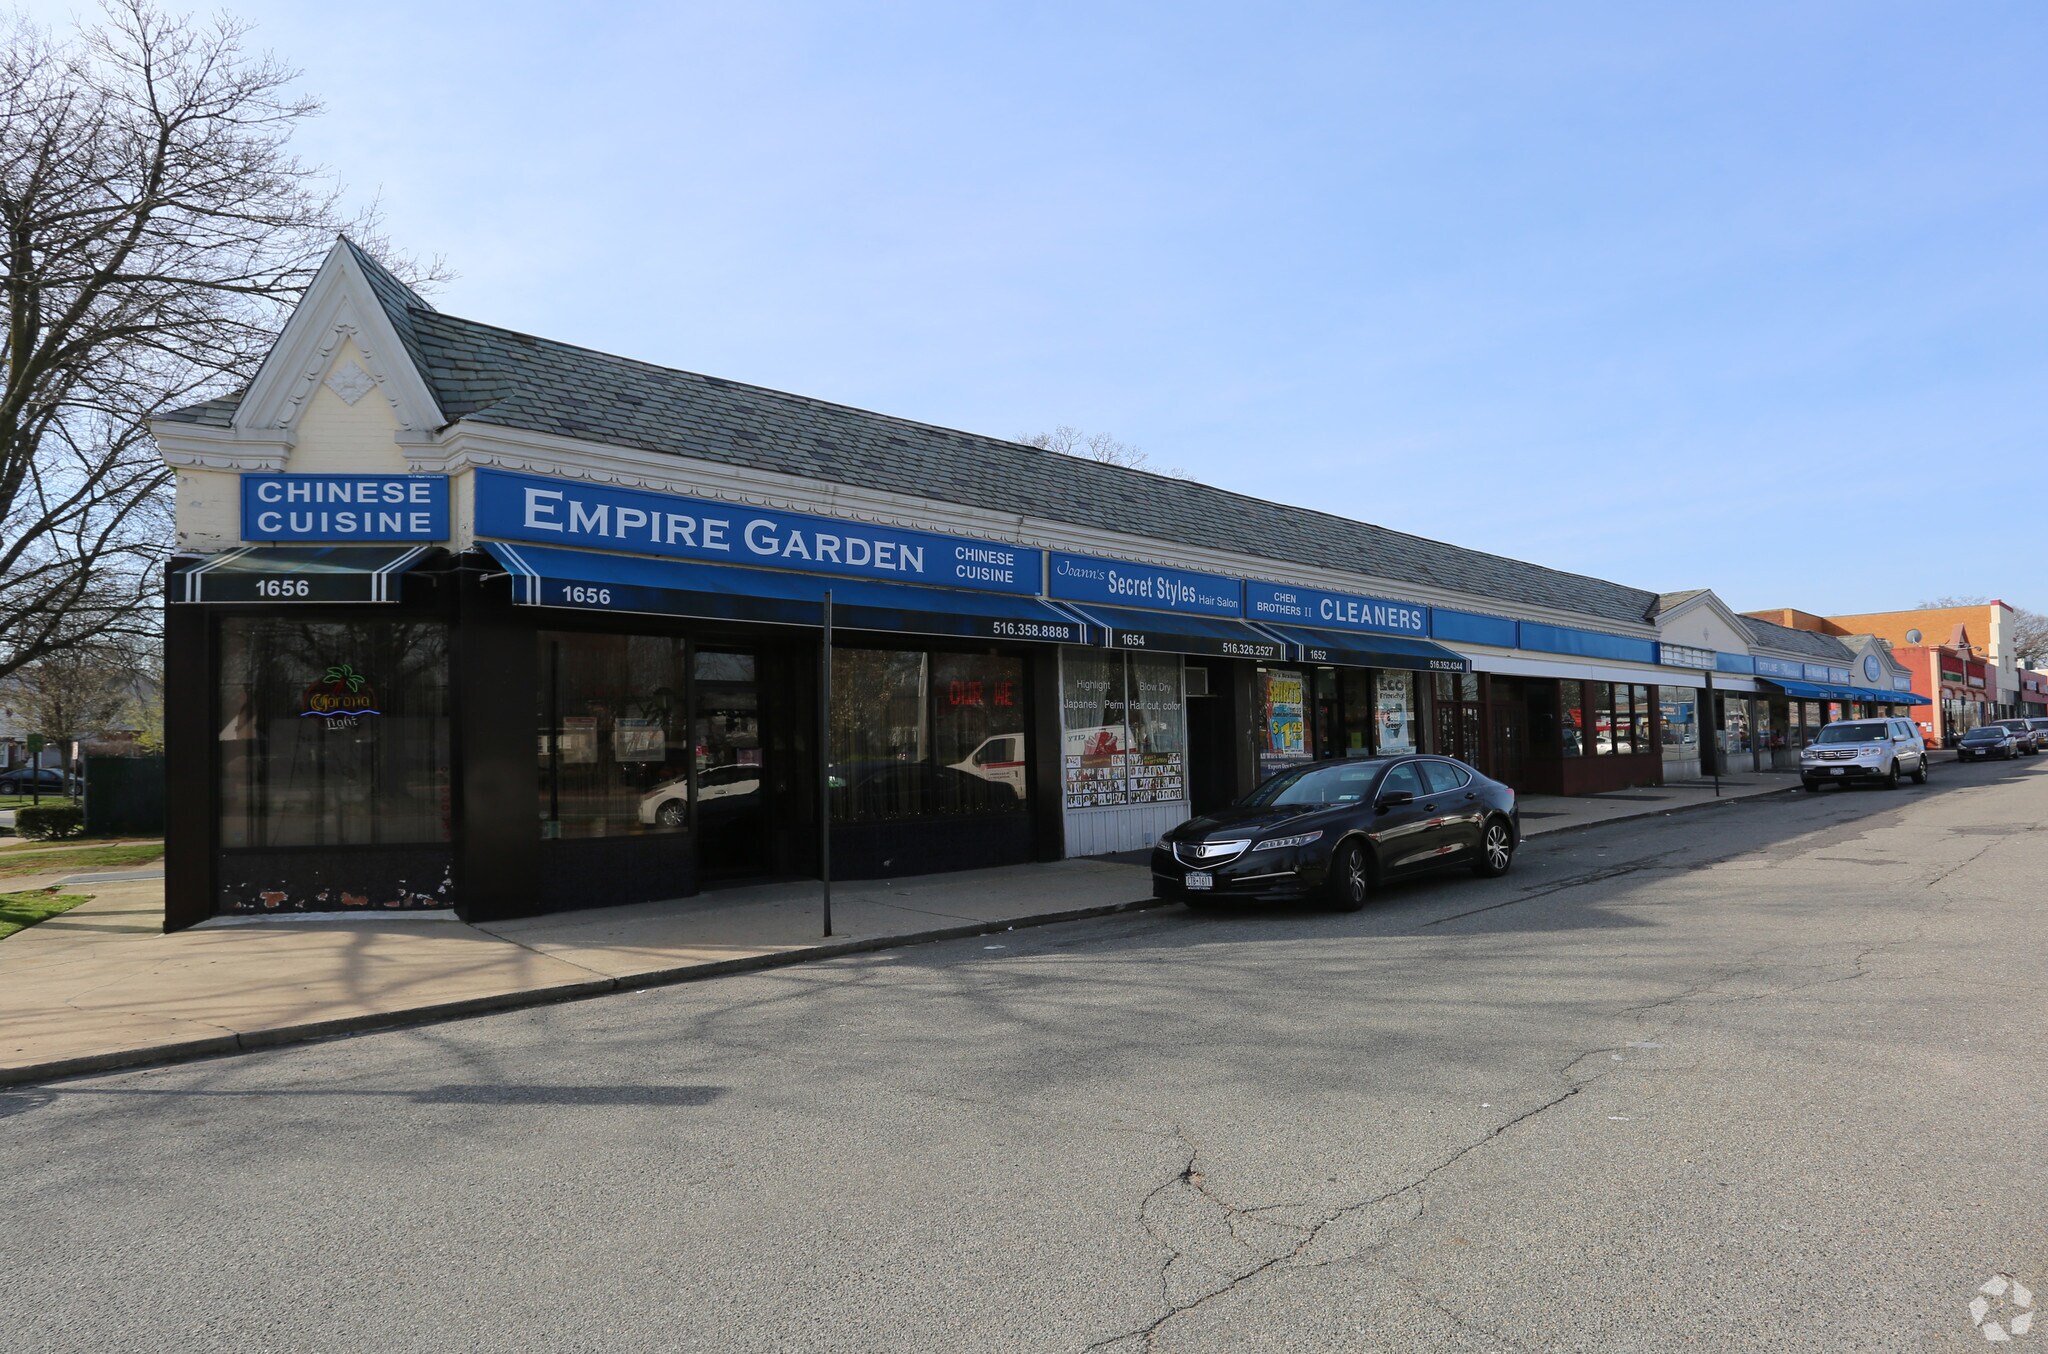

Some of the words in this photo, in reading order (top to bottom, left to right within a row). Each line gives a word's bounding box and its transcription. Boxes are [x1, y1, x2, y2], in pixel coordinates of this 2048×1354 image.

[257, 481, 431, 503] CHINESE
[257, 511, 431, 533] CUISINE
[523, 487, 730, 552] EMPIRE
[743, 519, 925, 573] GARDEN
[955, 547, 1014, 566] CHINESE
[955, 564, 1014, 583] CUISINE
[255, 579, 309, 597] 1656
[1056, 560, 1105, 580] Joann's
[1108, 570, 1152, 598] Secret
[1157, 576, 1196, 606] Styles
[1198, 594, 1215, 606] Hair
[1216, 597, 1239, 609] Salon
[562, 585, 611, 605] 1656
[1274, 592, 1296, 604] CHEN
[1257, 601, 1301, 616] BROTHERS
[1320, 598, 1422, 630] CLEANERS
[993, 621, 1069, 639] 516.358.8888
[1121, 633, 1145, 646] 1654
[1222, 642, 1274, 656] 516.326.2527
[1310, 649, 1327, 661] 1652
[1429, 659, 1463, 671] 516.352.4344
[1076, 680, 1110, 691] Highlight
[1139, 681, 1157, 691] Blow
[1159, 682, 1171, 693] Dry
[1104, 699, 1125, 710] Perm
[1129, 701, 1145, 710] Hair
[1162, 701, 1181, 711] color
